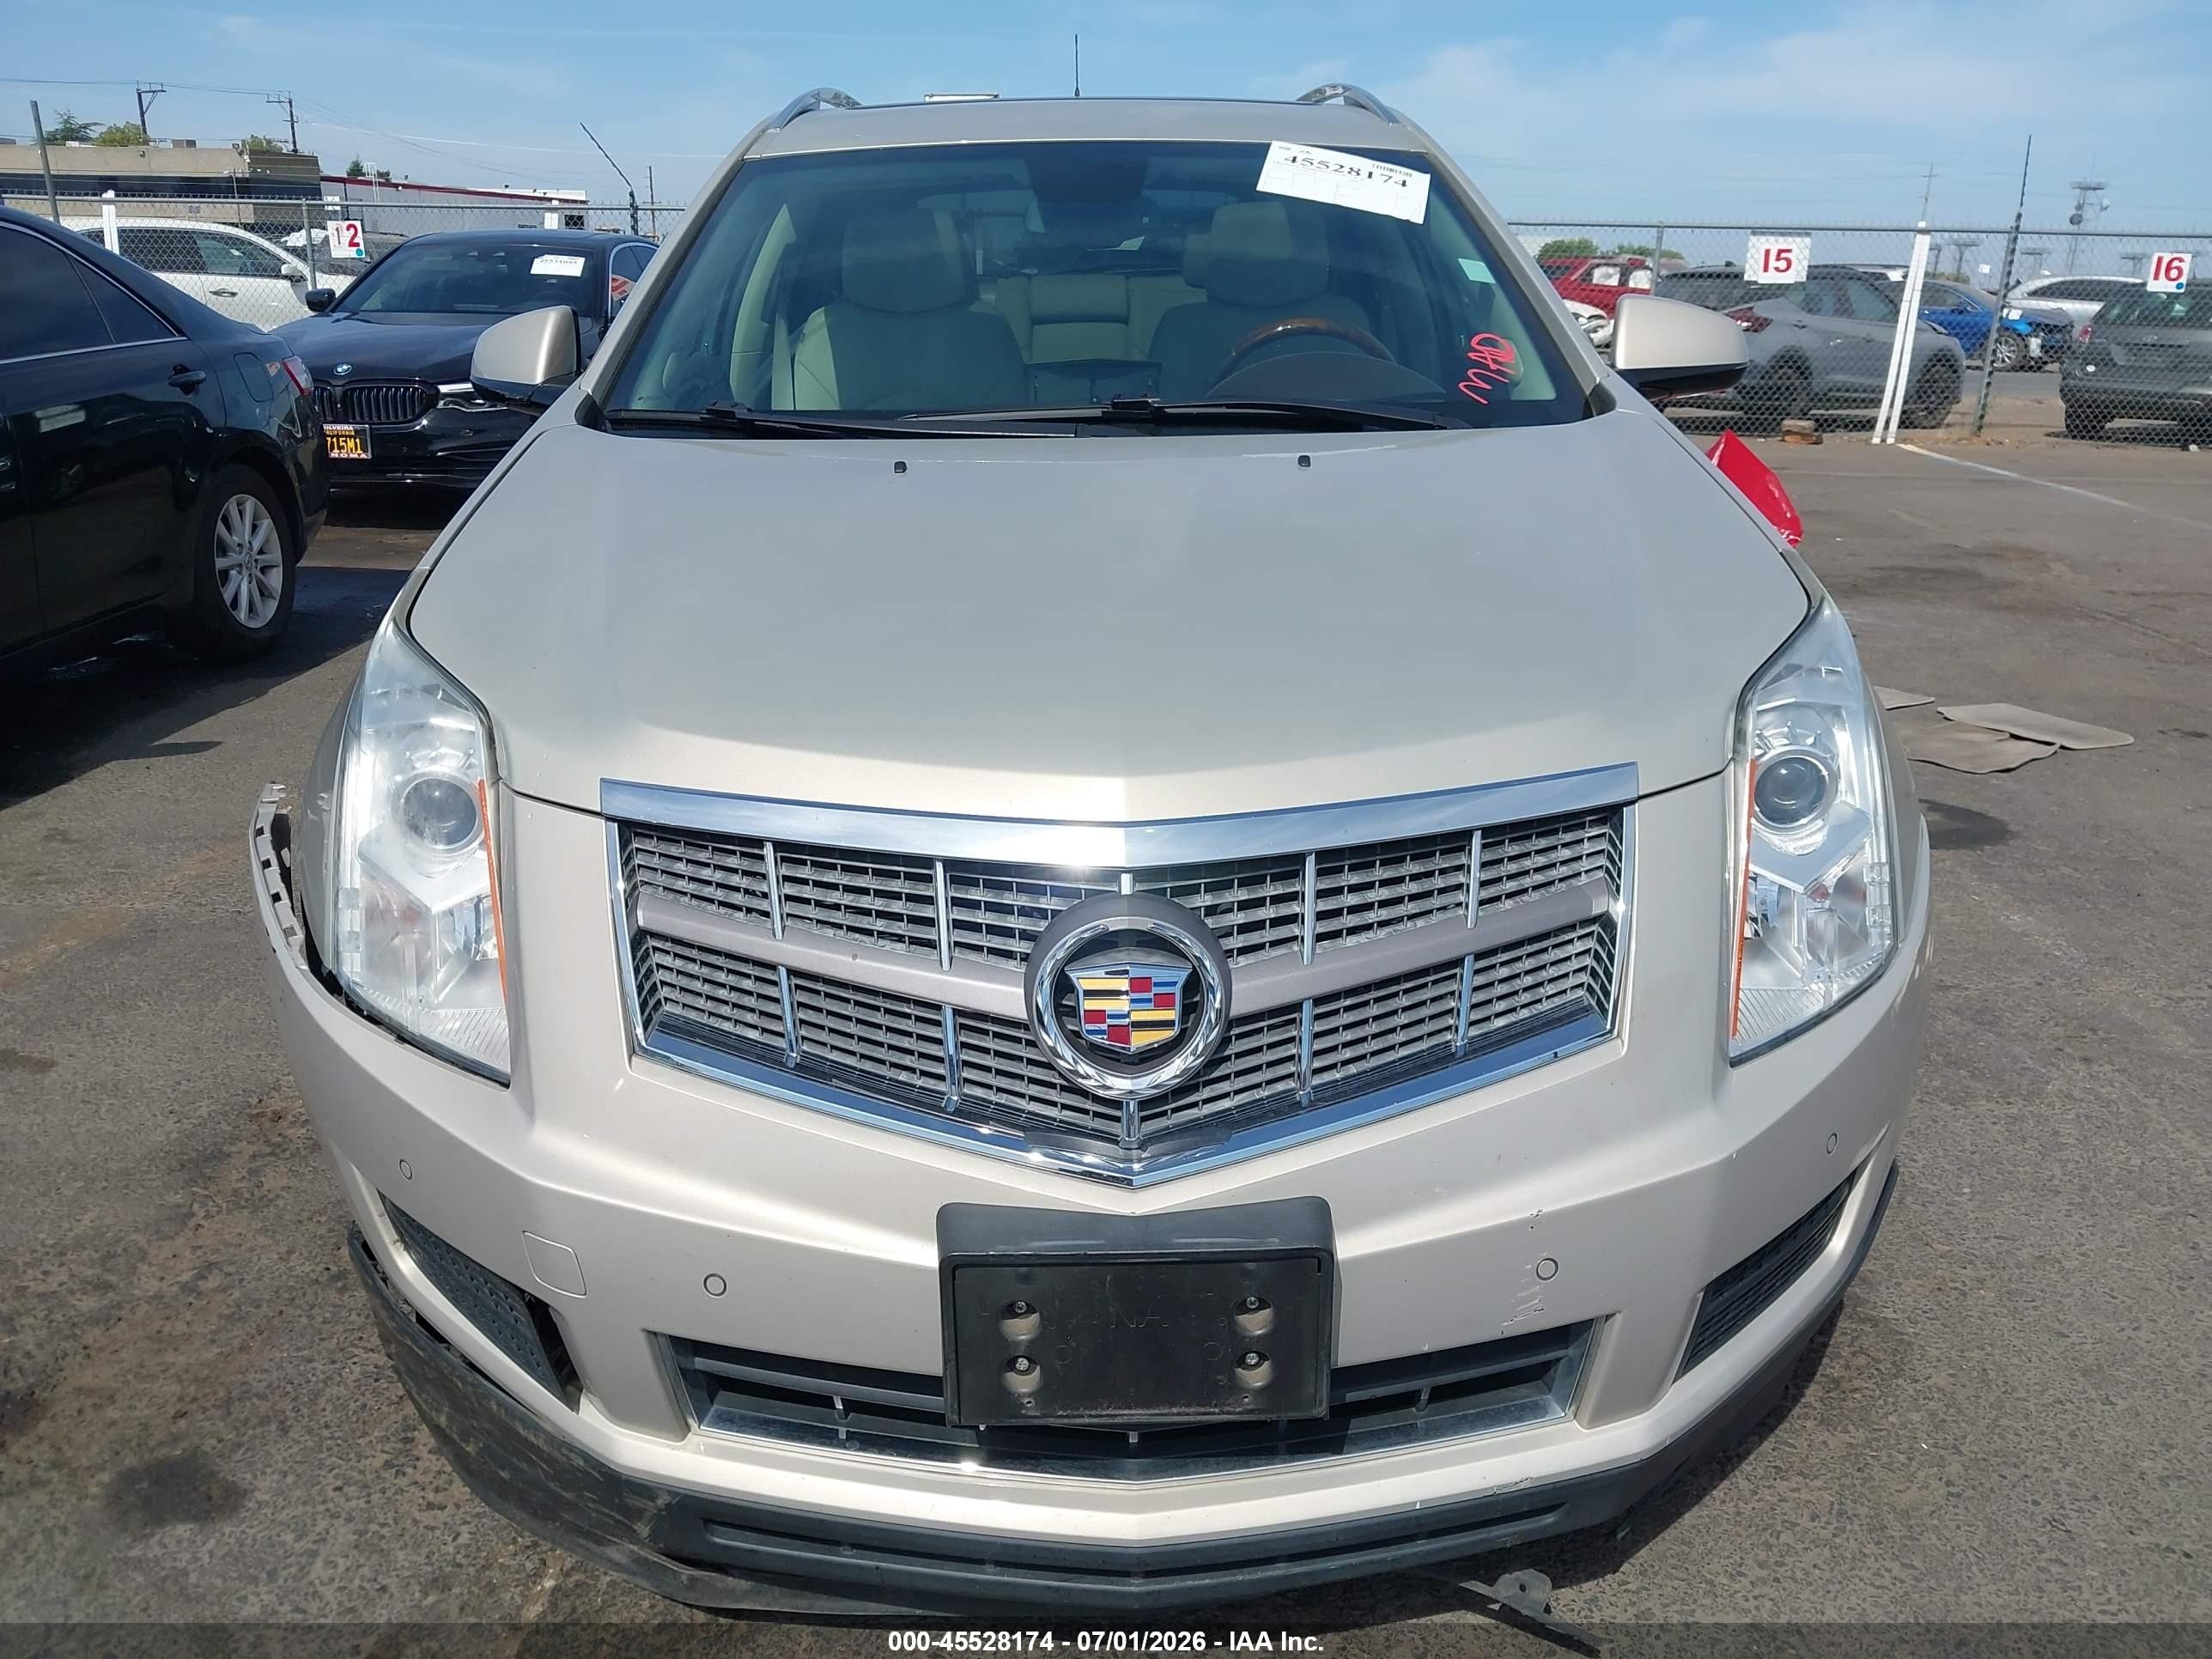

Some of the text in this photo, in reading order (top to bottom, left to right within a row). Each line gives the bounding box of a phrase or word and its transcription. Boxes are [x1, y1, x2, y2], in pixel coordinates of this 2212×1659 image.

[1284, 155, 1408, 187] 45528174
[335, 223, 361, 247] 12
[1762, 248, 1793, 273] 15
[2153, 256, 2185, 282] 16
